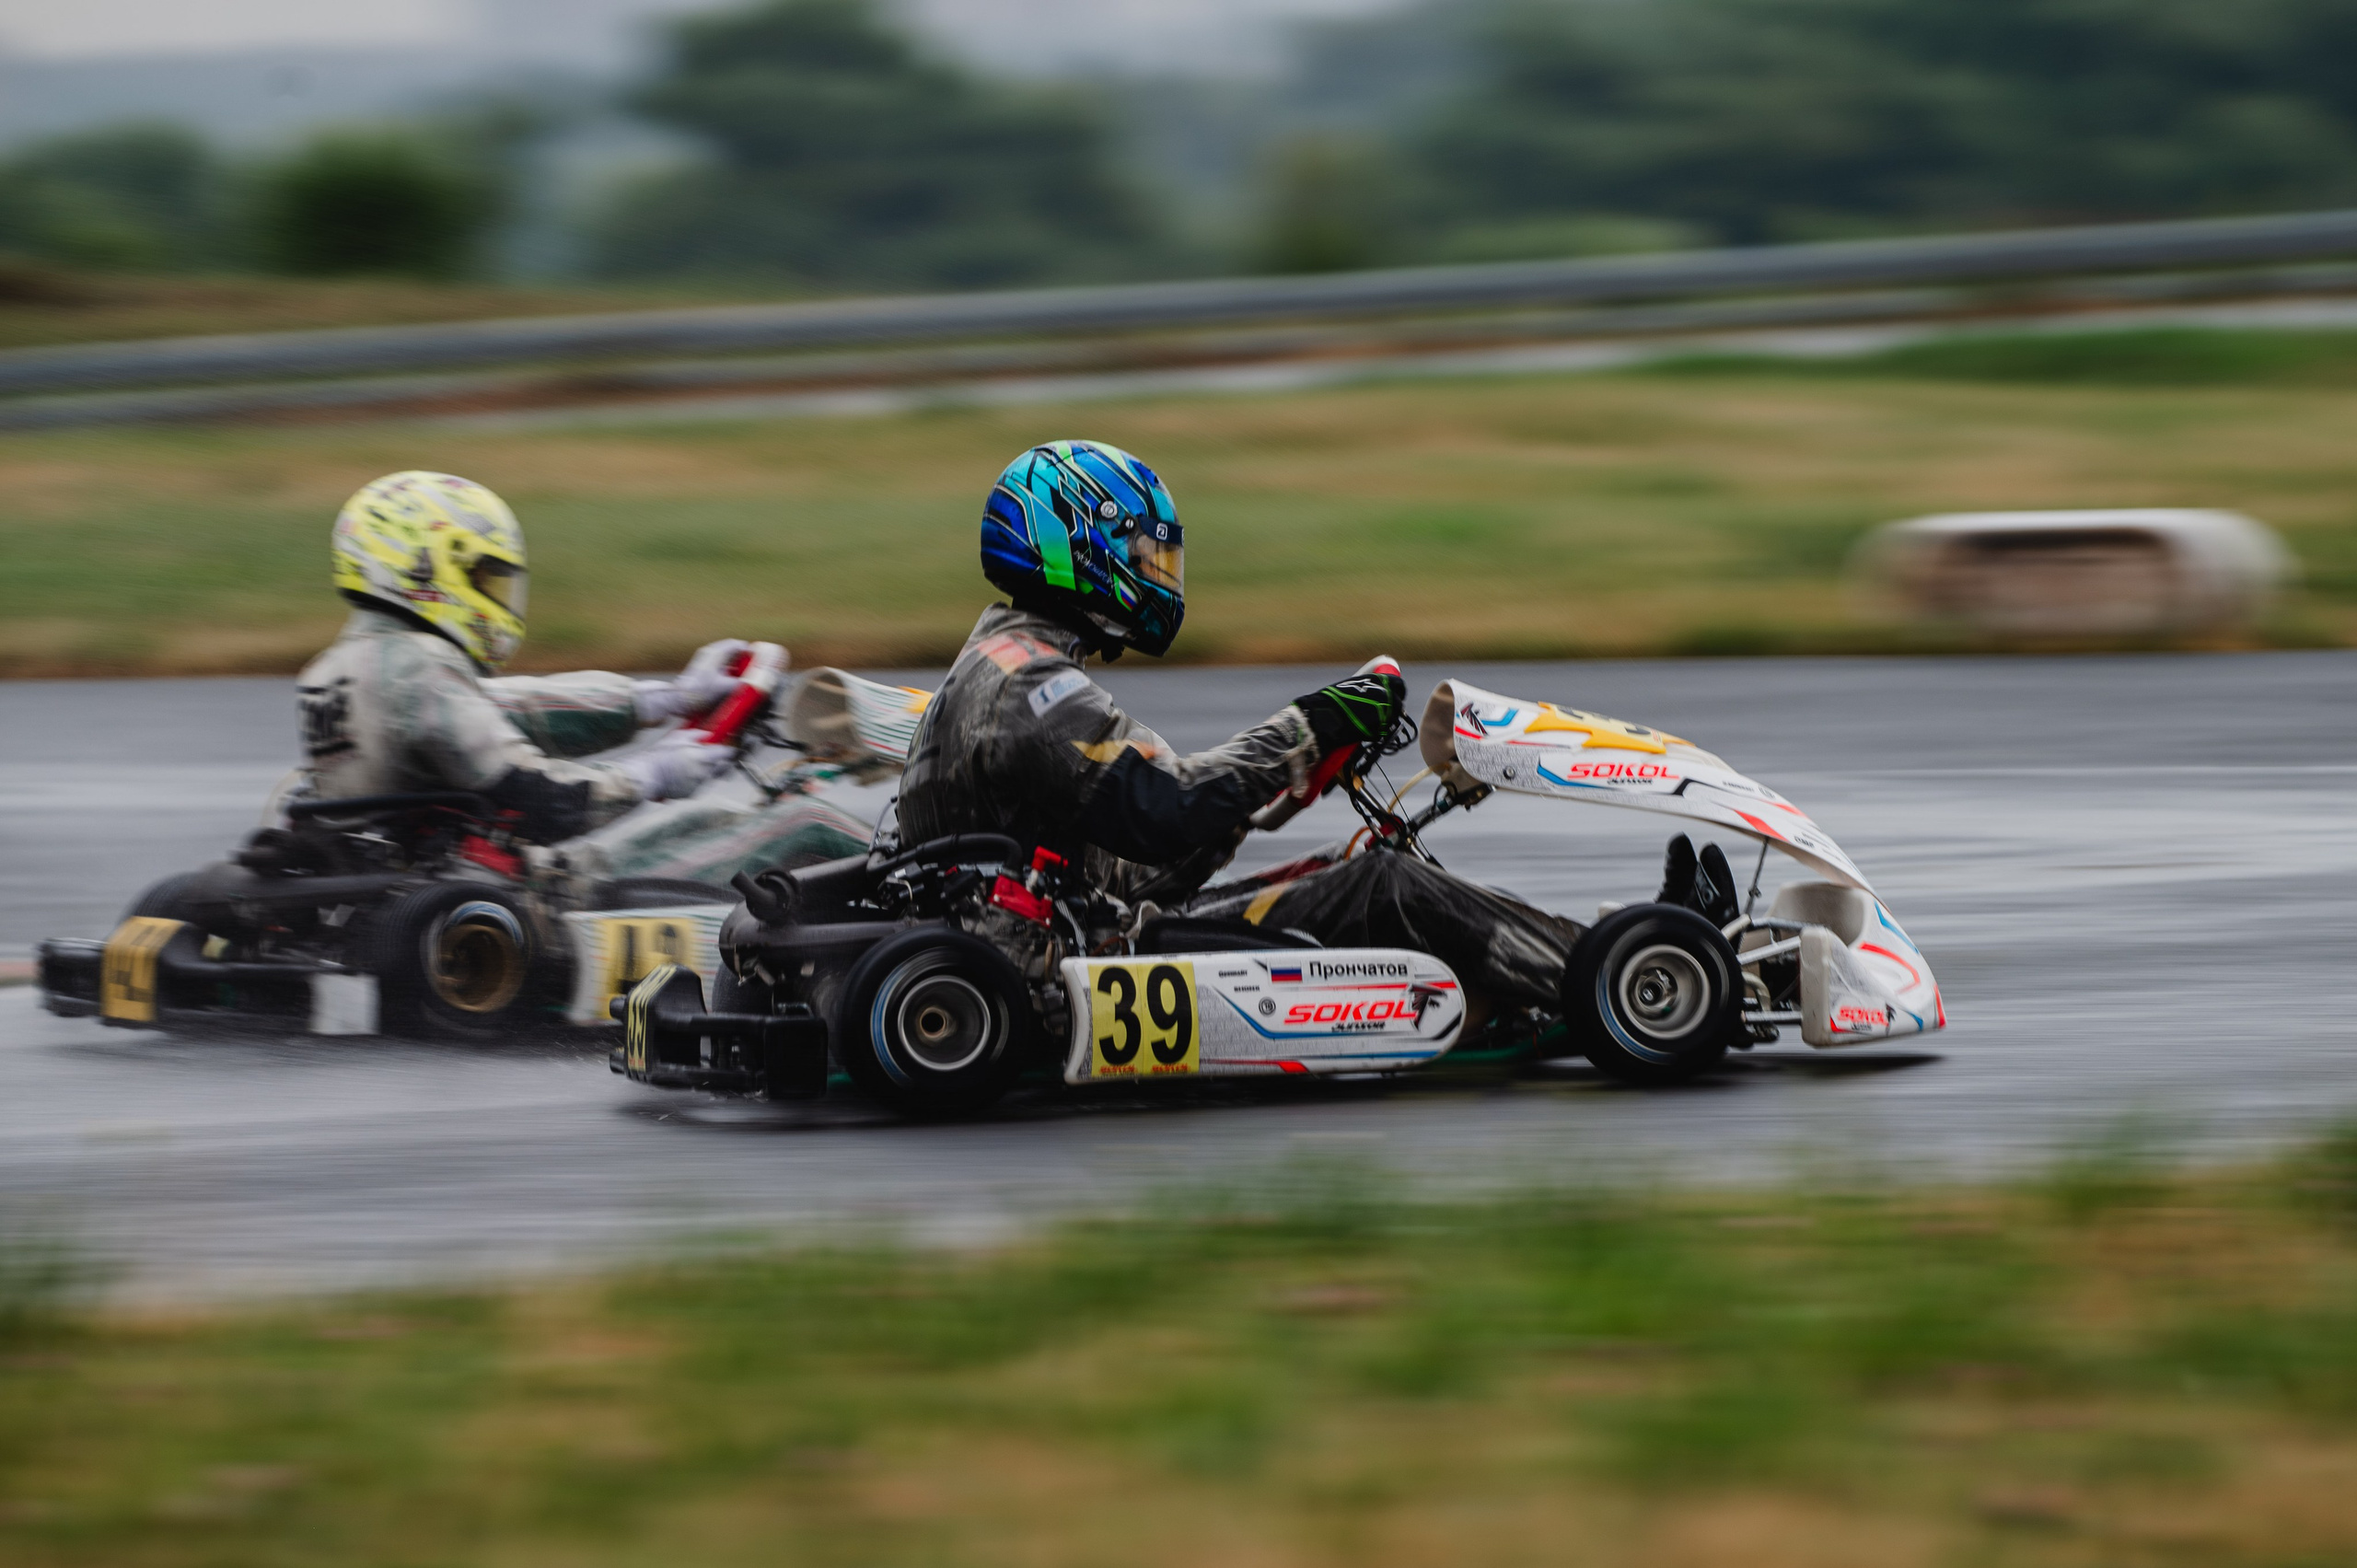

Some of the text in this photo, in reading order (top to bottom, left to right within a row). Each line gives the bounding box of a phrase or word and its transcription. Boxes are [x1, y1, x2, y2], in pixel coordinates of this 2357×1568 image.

[1567, 763, 1679, 780] SOKOL
[1309, 961, 1408, 980] Прончатов
[1097, 965, 1193, 1065] 39
[1284, 999, 1418, 1025] SOKOL
